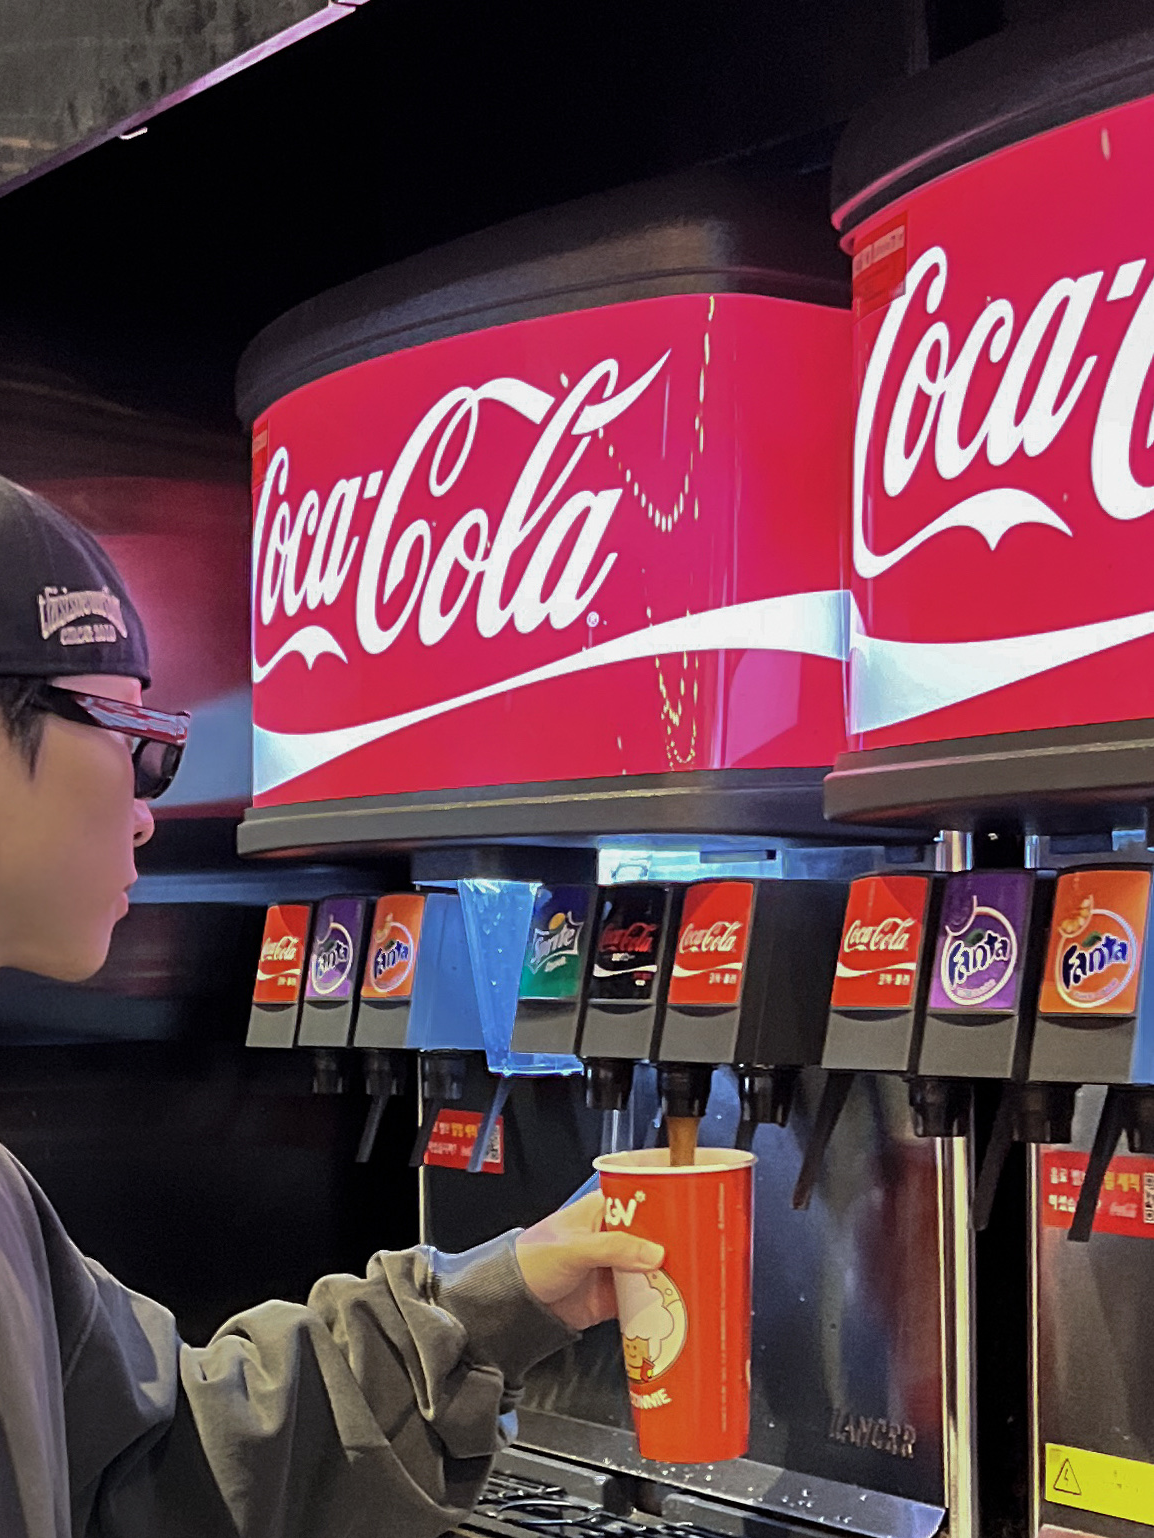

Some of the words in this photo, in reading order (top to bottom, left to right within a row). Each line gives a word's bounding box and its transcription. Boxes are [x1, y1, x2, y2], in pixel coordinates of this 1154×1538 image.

[252, 348, 672, 680] Coca-Cola
[374, 938, 410, 981] Fanta
[947, 929, 1012, 992] Fanta
[1061, 933, 1130, 993] Fanta
